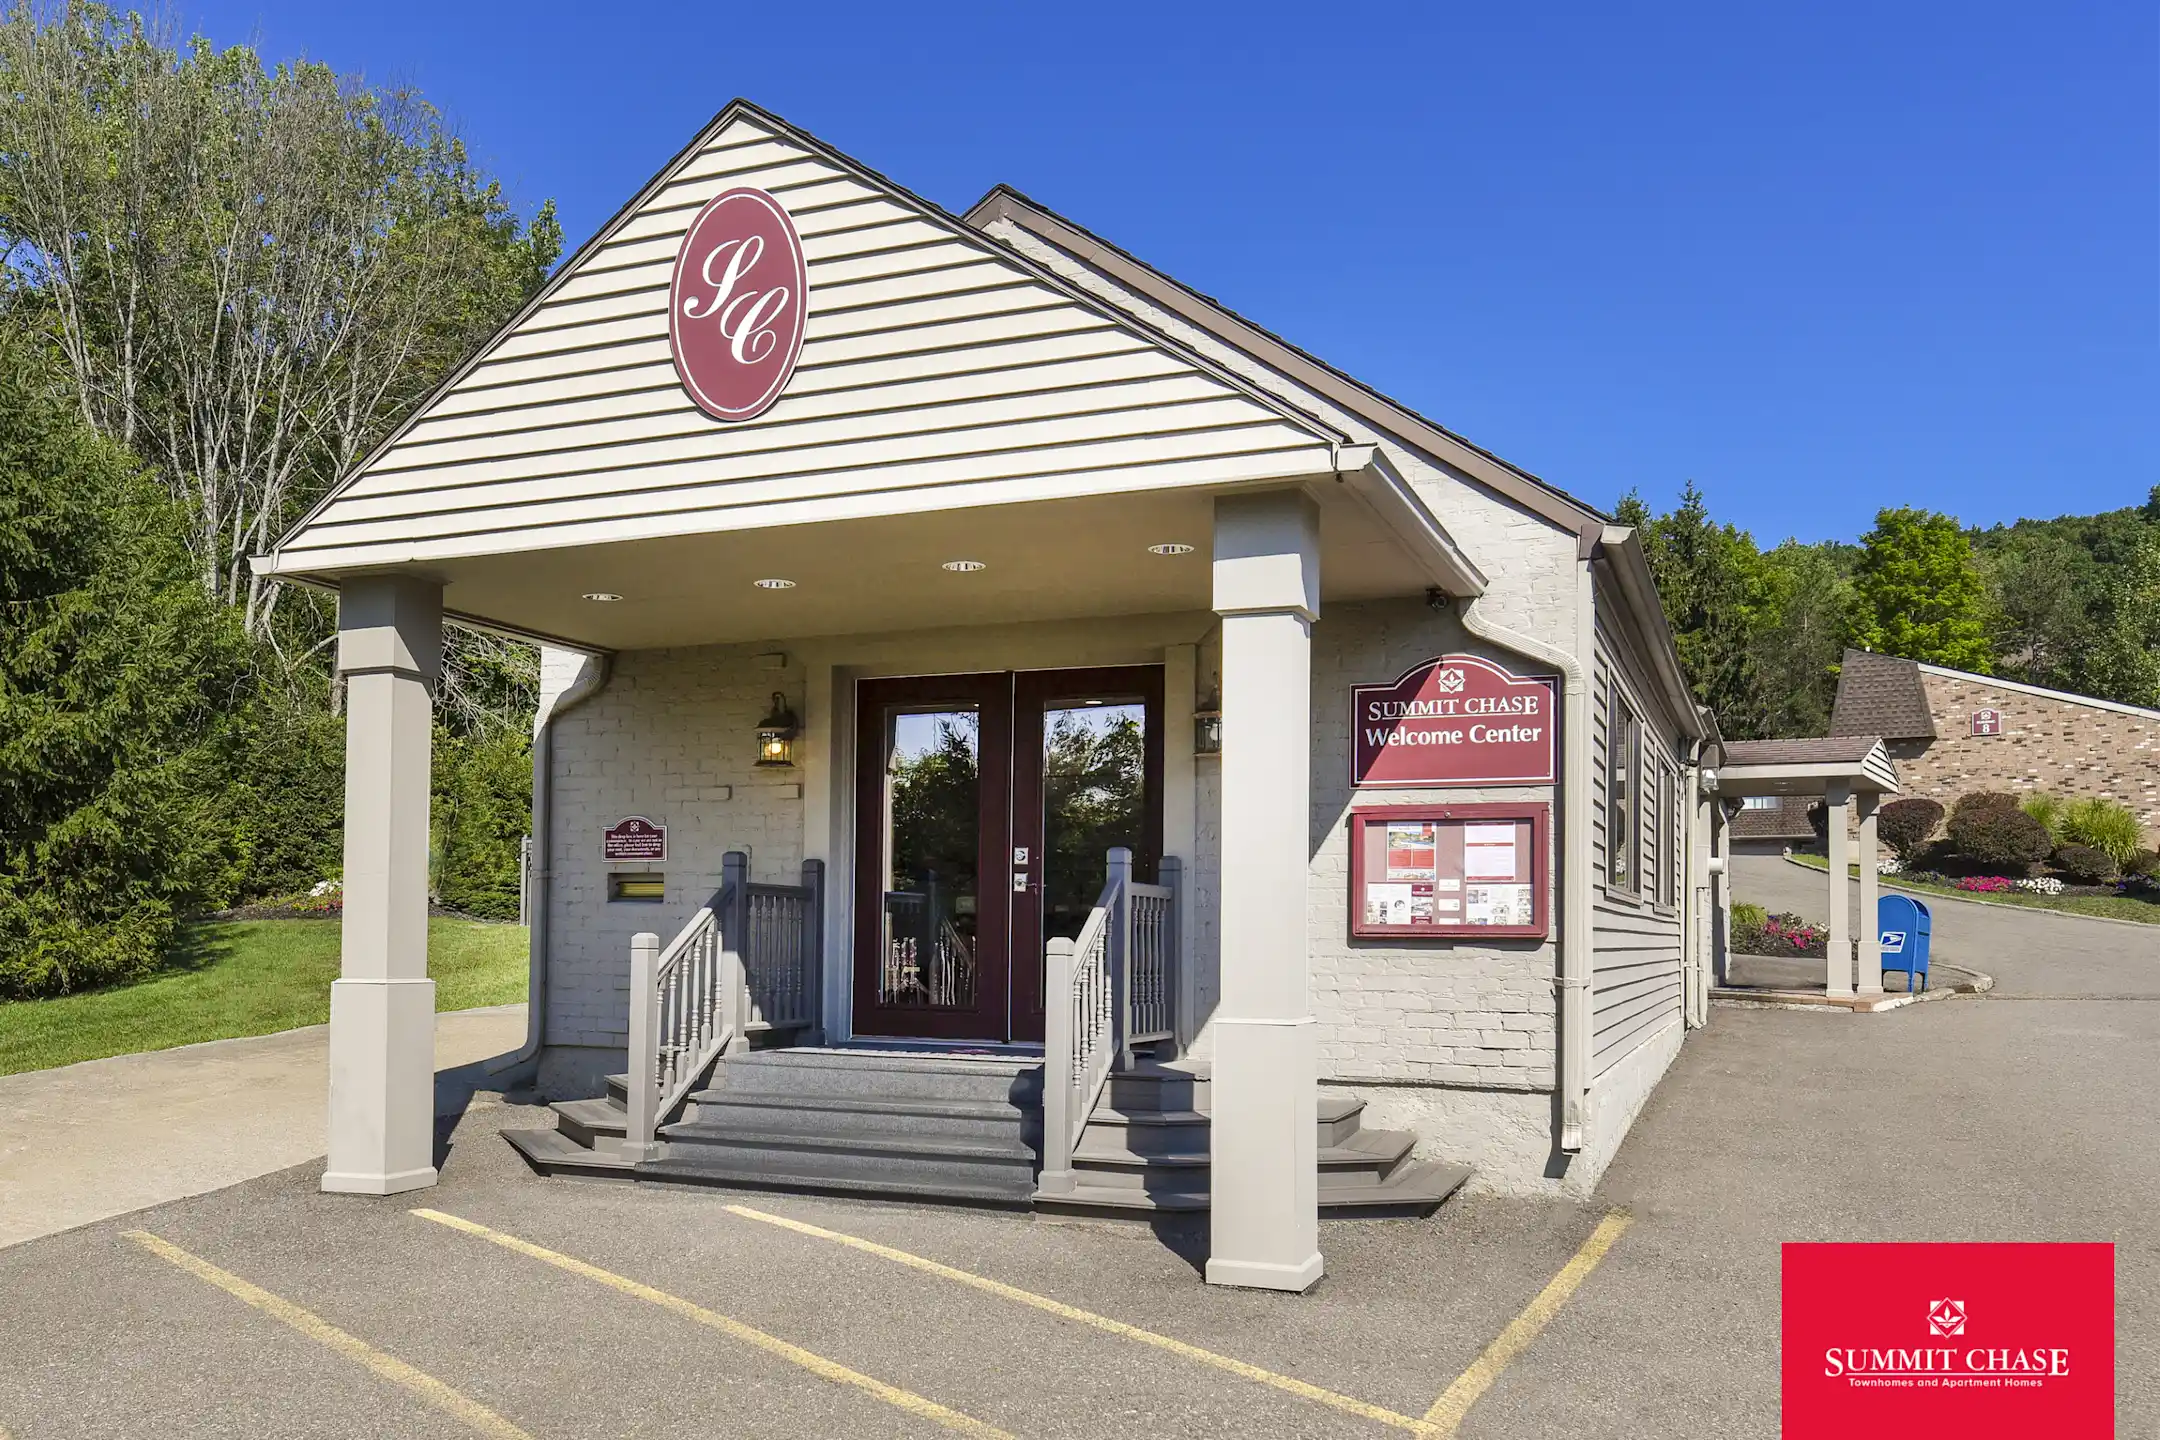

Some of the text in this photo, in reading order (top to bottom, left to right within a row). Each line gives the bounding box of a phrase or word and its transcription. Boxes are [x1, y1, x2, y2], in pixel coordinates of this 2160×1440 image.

[1368, 696, 1539, 721] SUMMIT CHASE
[1365, 724, 1542, 747] Welcome Center
[1982, 723, 1990, 733] 8
